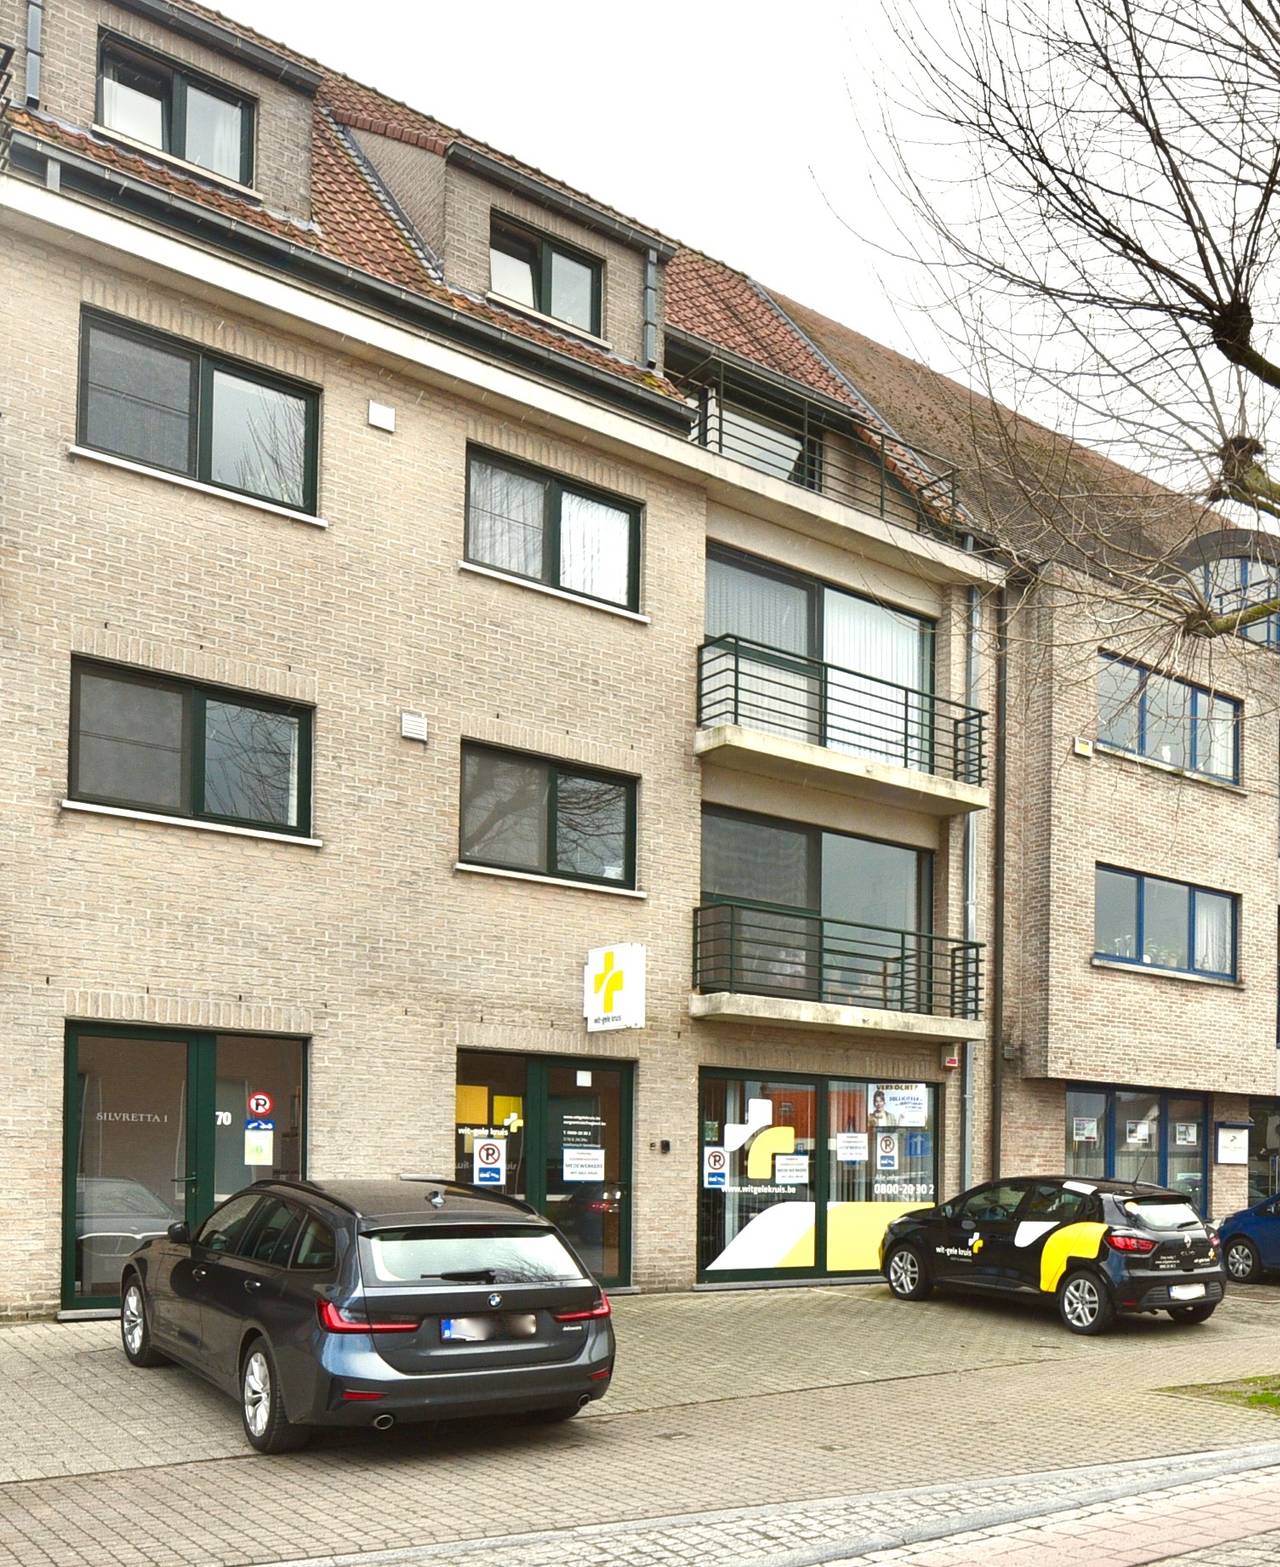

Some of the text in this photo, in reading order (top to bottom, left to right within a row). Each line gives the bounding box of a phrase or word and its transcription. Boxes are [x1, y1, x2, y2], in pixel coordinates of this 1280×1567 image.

[96, 1112, 161, 1123] SILVRETTA
[215, 1111, 232, 1126] 70
[722, 1185, 796, 1195] www.witgelekruis.be
